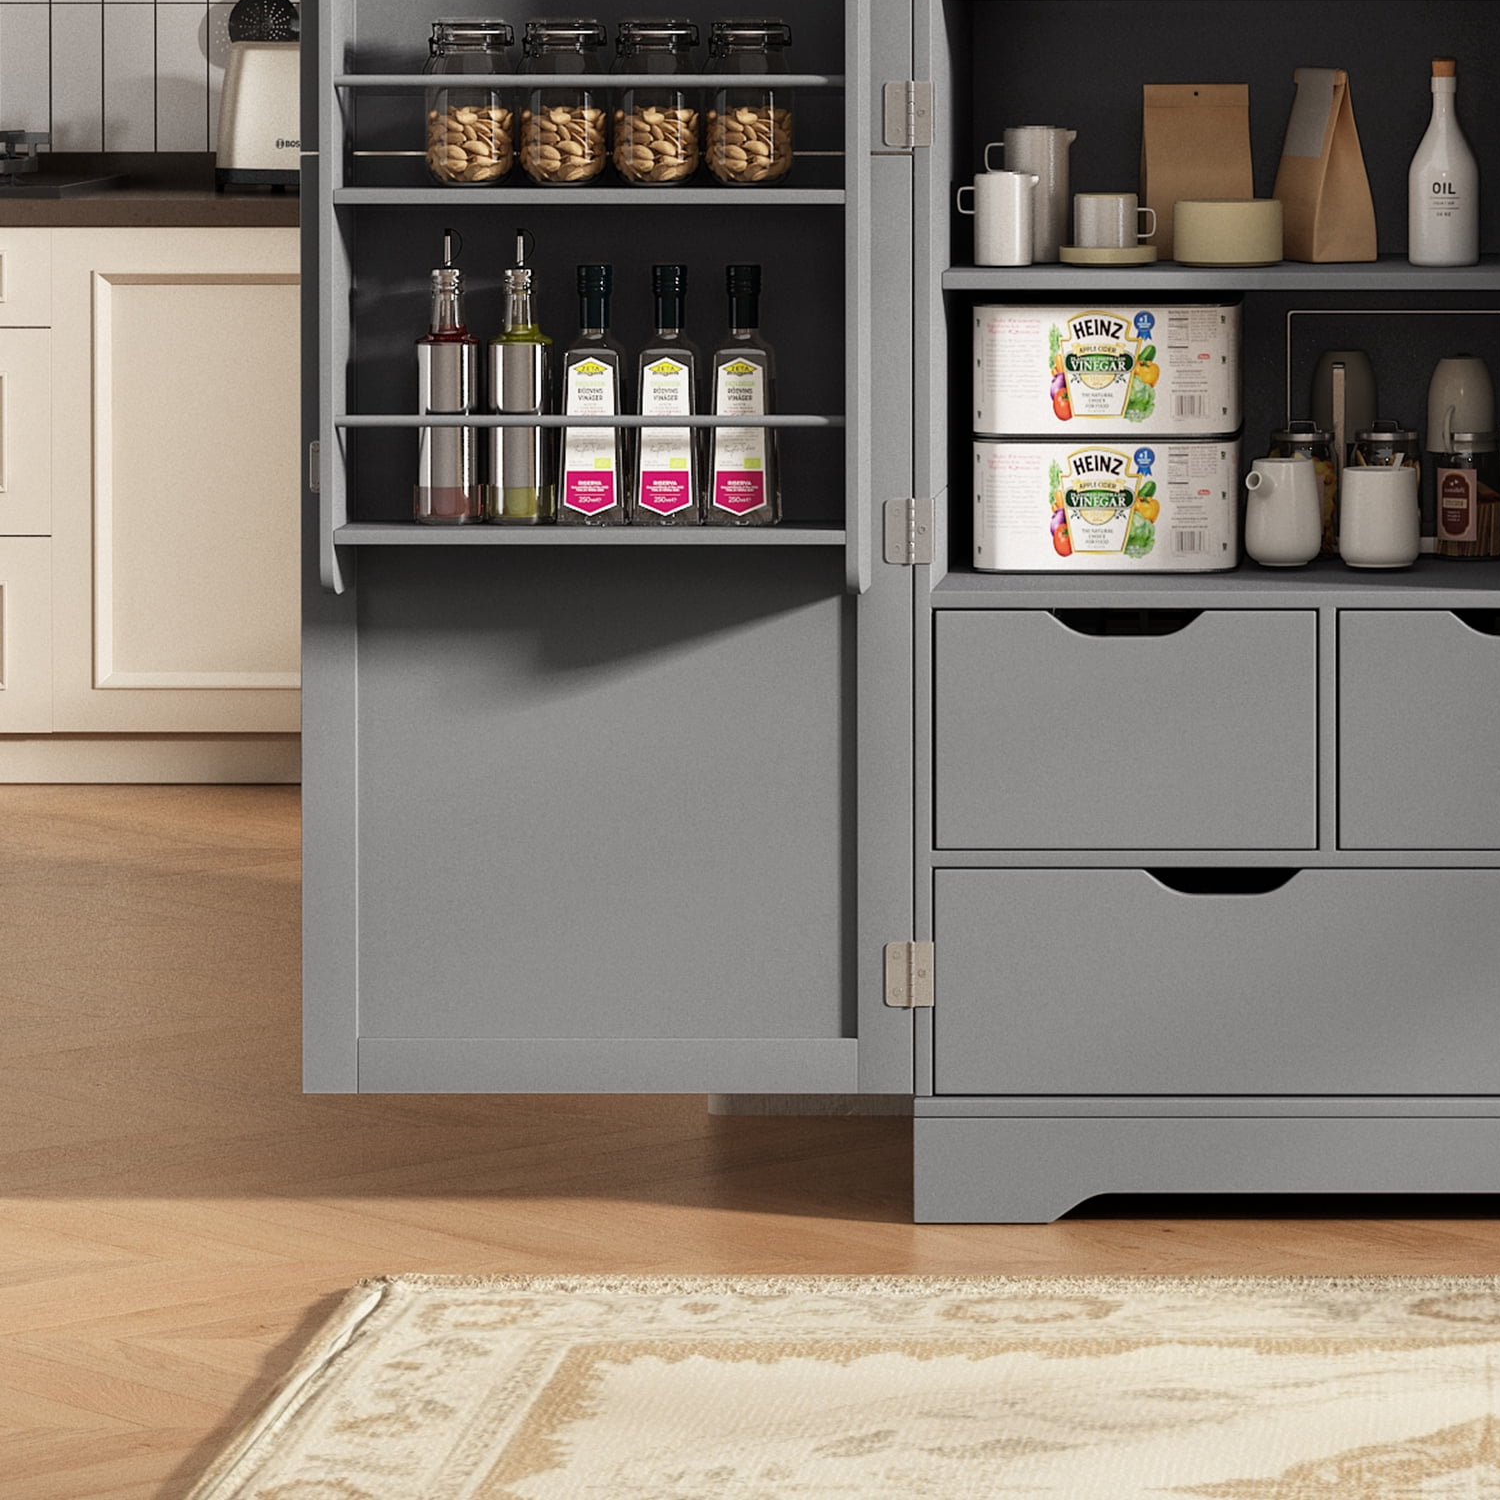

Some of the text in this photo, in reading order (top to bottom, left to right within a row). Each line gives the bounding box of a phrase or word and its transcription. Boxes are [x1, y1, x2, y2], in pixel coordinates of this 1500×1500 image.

[285, 140, 301, 148] BOS
[1432, 182, 1456, 194] OIL
[1073, 319, 1123, 340] HEINZ
[1070, 360, 1126, 371] VINEGAR
[1073, 455, 1123, 476] HEINZ
[1070, 496, 1126, 508] VINEGAR
